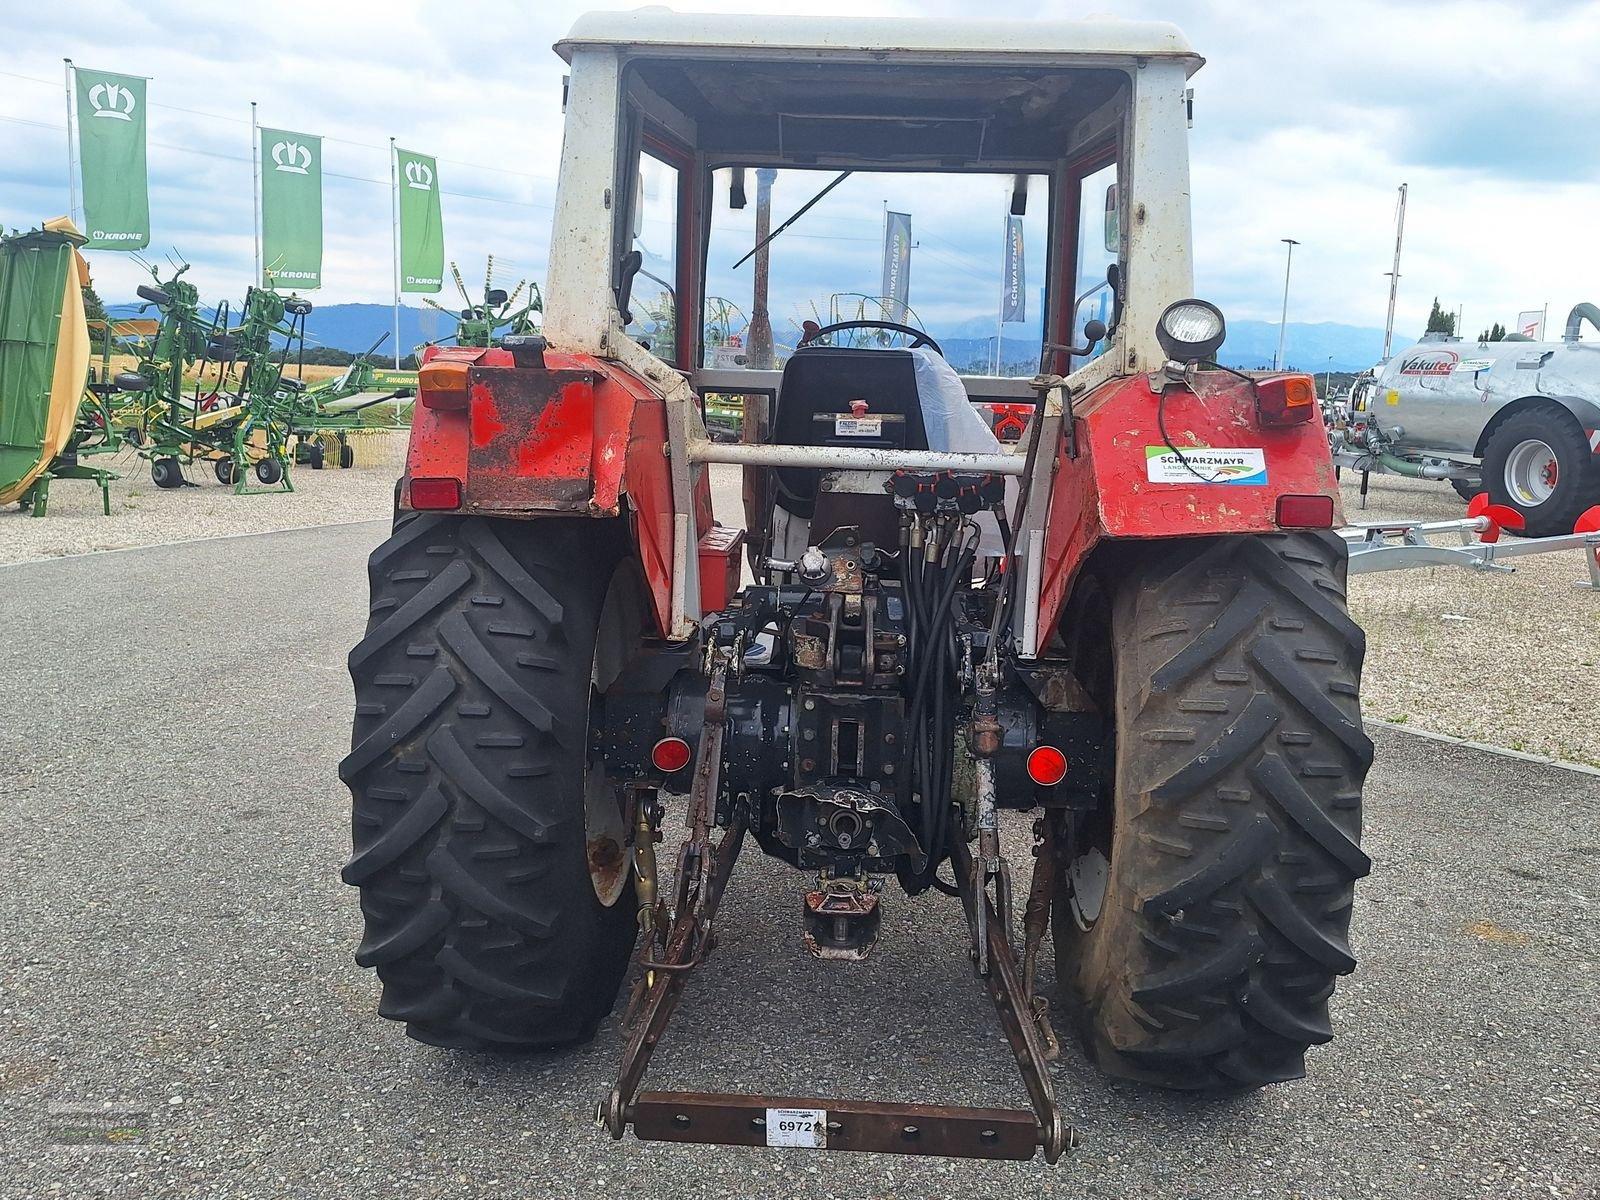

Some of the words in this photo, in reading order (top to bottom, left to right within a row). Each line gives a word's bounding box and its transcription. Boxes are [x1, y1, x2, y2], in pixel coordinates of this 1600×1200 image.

[280, 271, 317, 279] KRONE
[1400, 356, 1455, 374] Vakutec
[1160, 456, 1244, 465] SCHWARZMAYR
